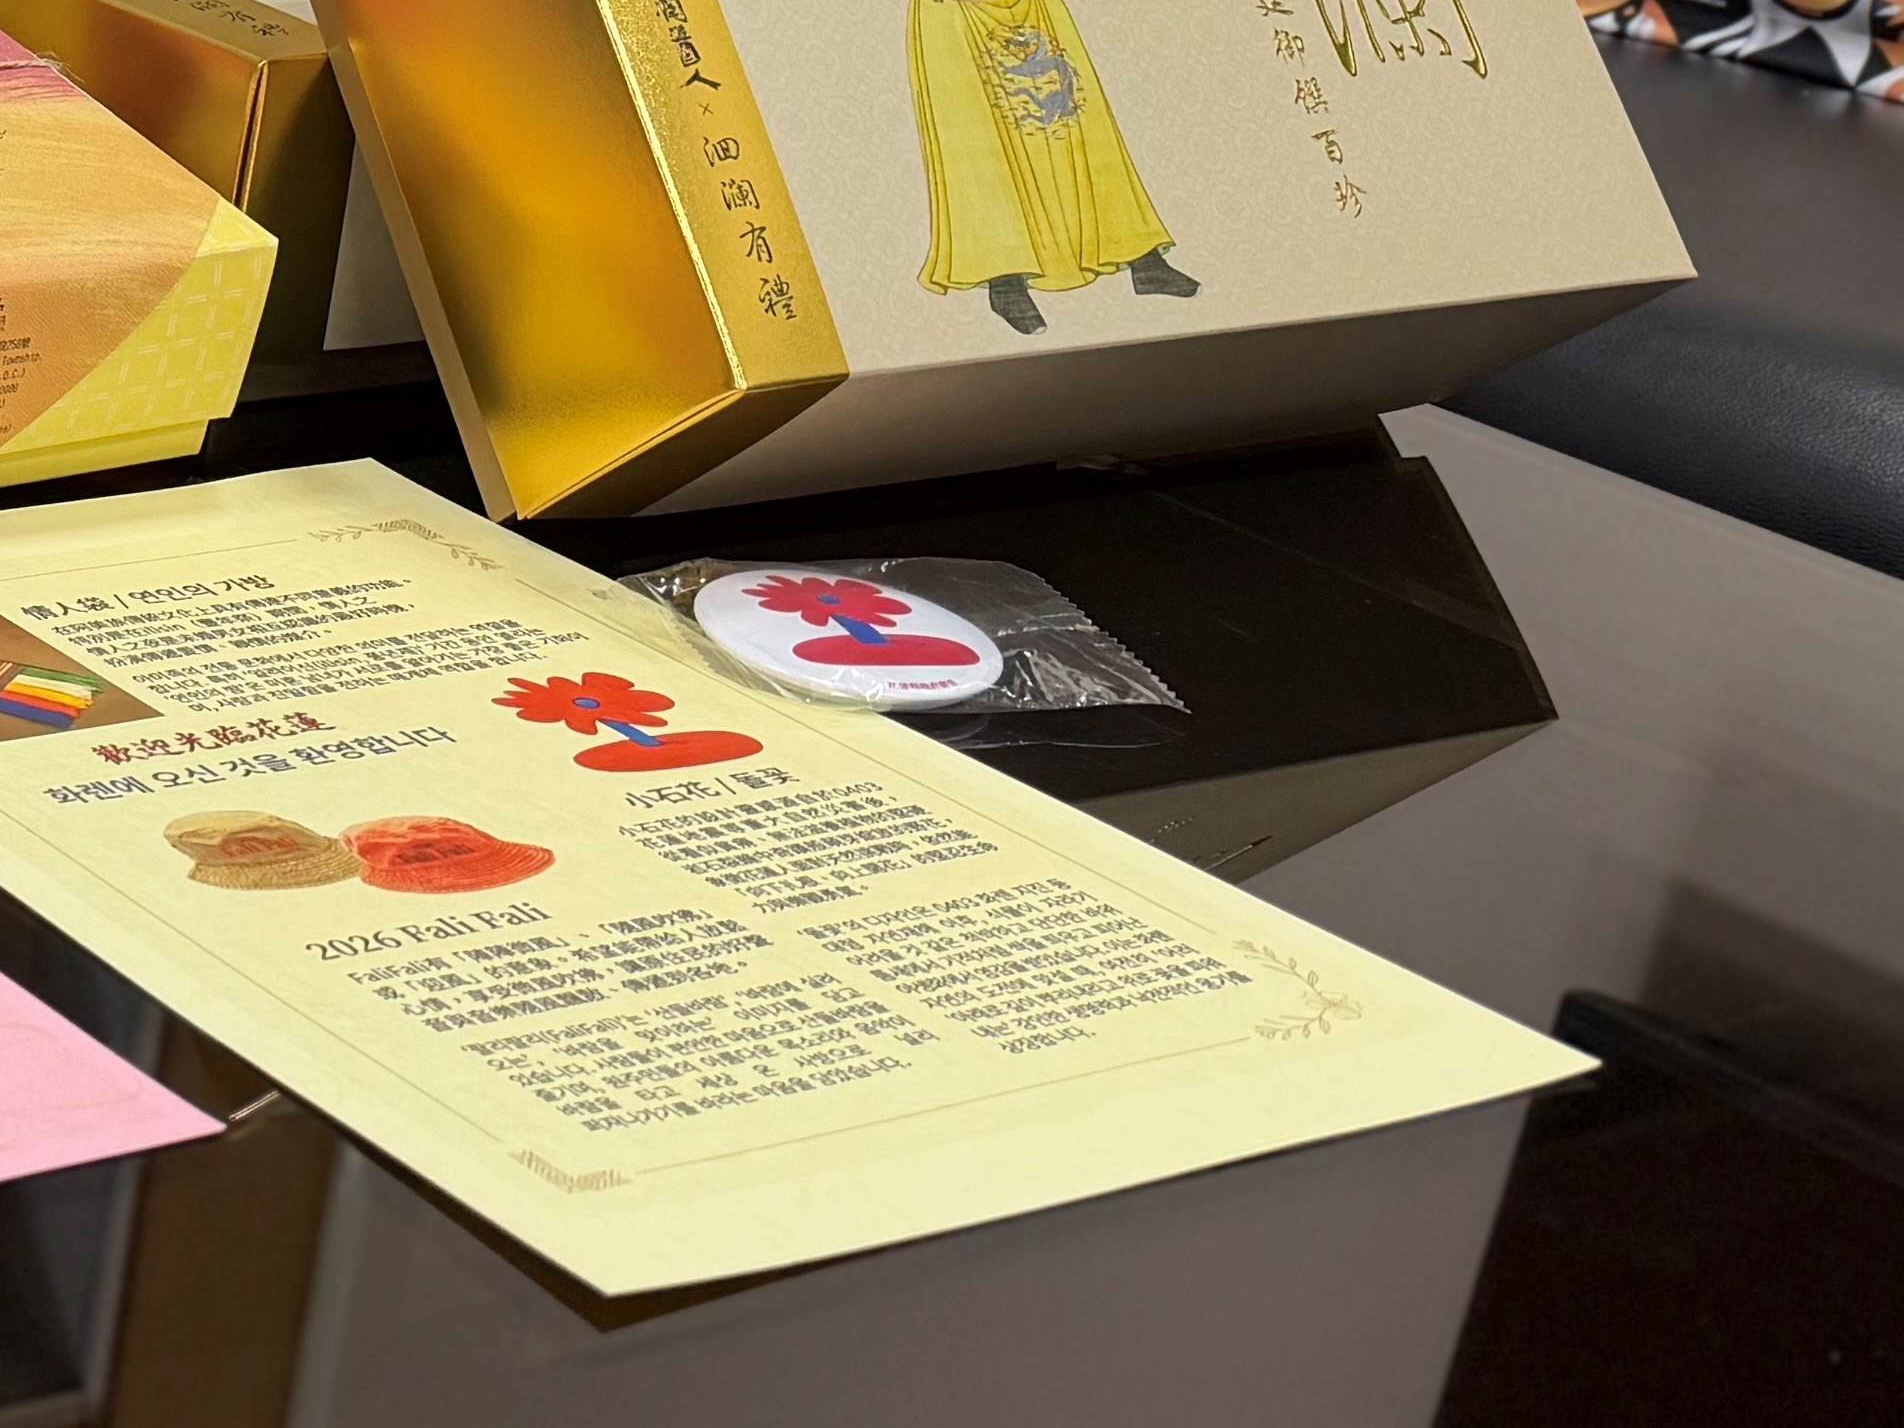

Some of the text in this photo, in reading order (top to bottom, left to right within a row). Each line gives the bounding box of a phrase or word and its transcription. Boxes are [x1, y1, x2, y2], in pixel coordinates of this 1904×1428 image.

[20, 574, 274, 620] 情人袋 연인의 가방
[92, 712, 333, 764] 歡迎光臨花蓮
[43, 726, 455, 803] 화렌에 오신 것을 환영합니다
[625, 767, 799, 808] 小石花 돌꽃
[305, 902, 550, 960] 2026 Fali Fali
